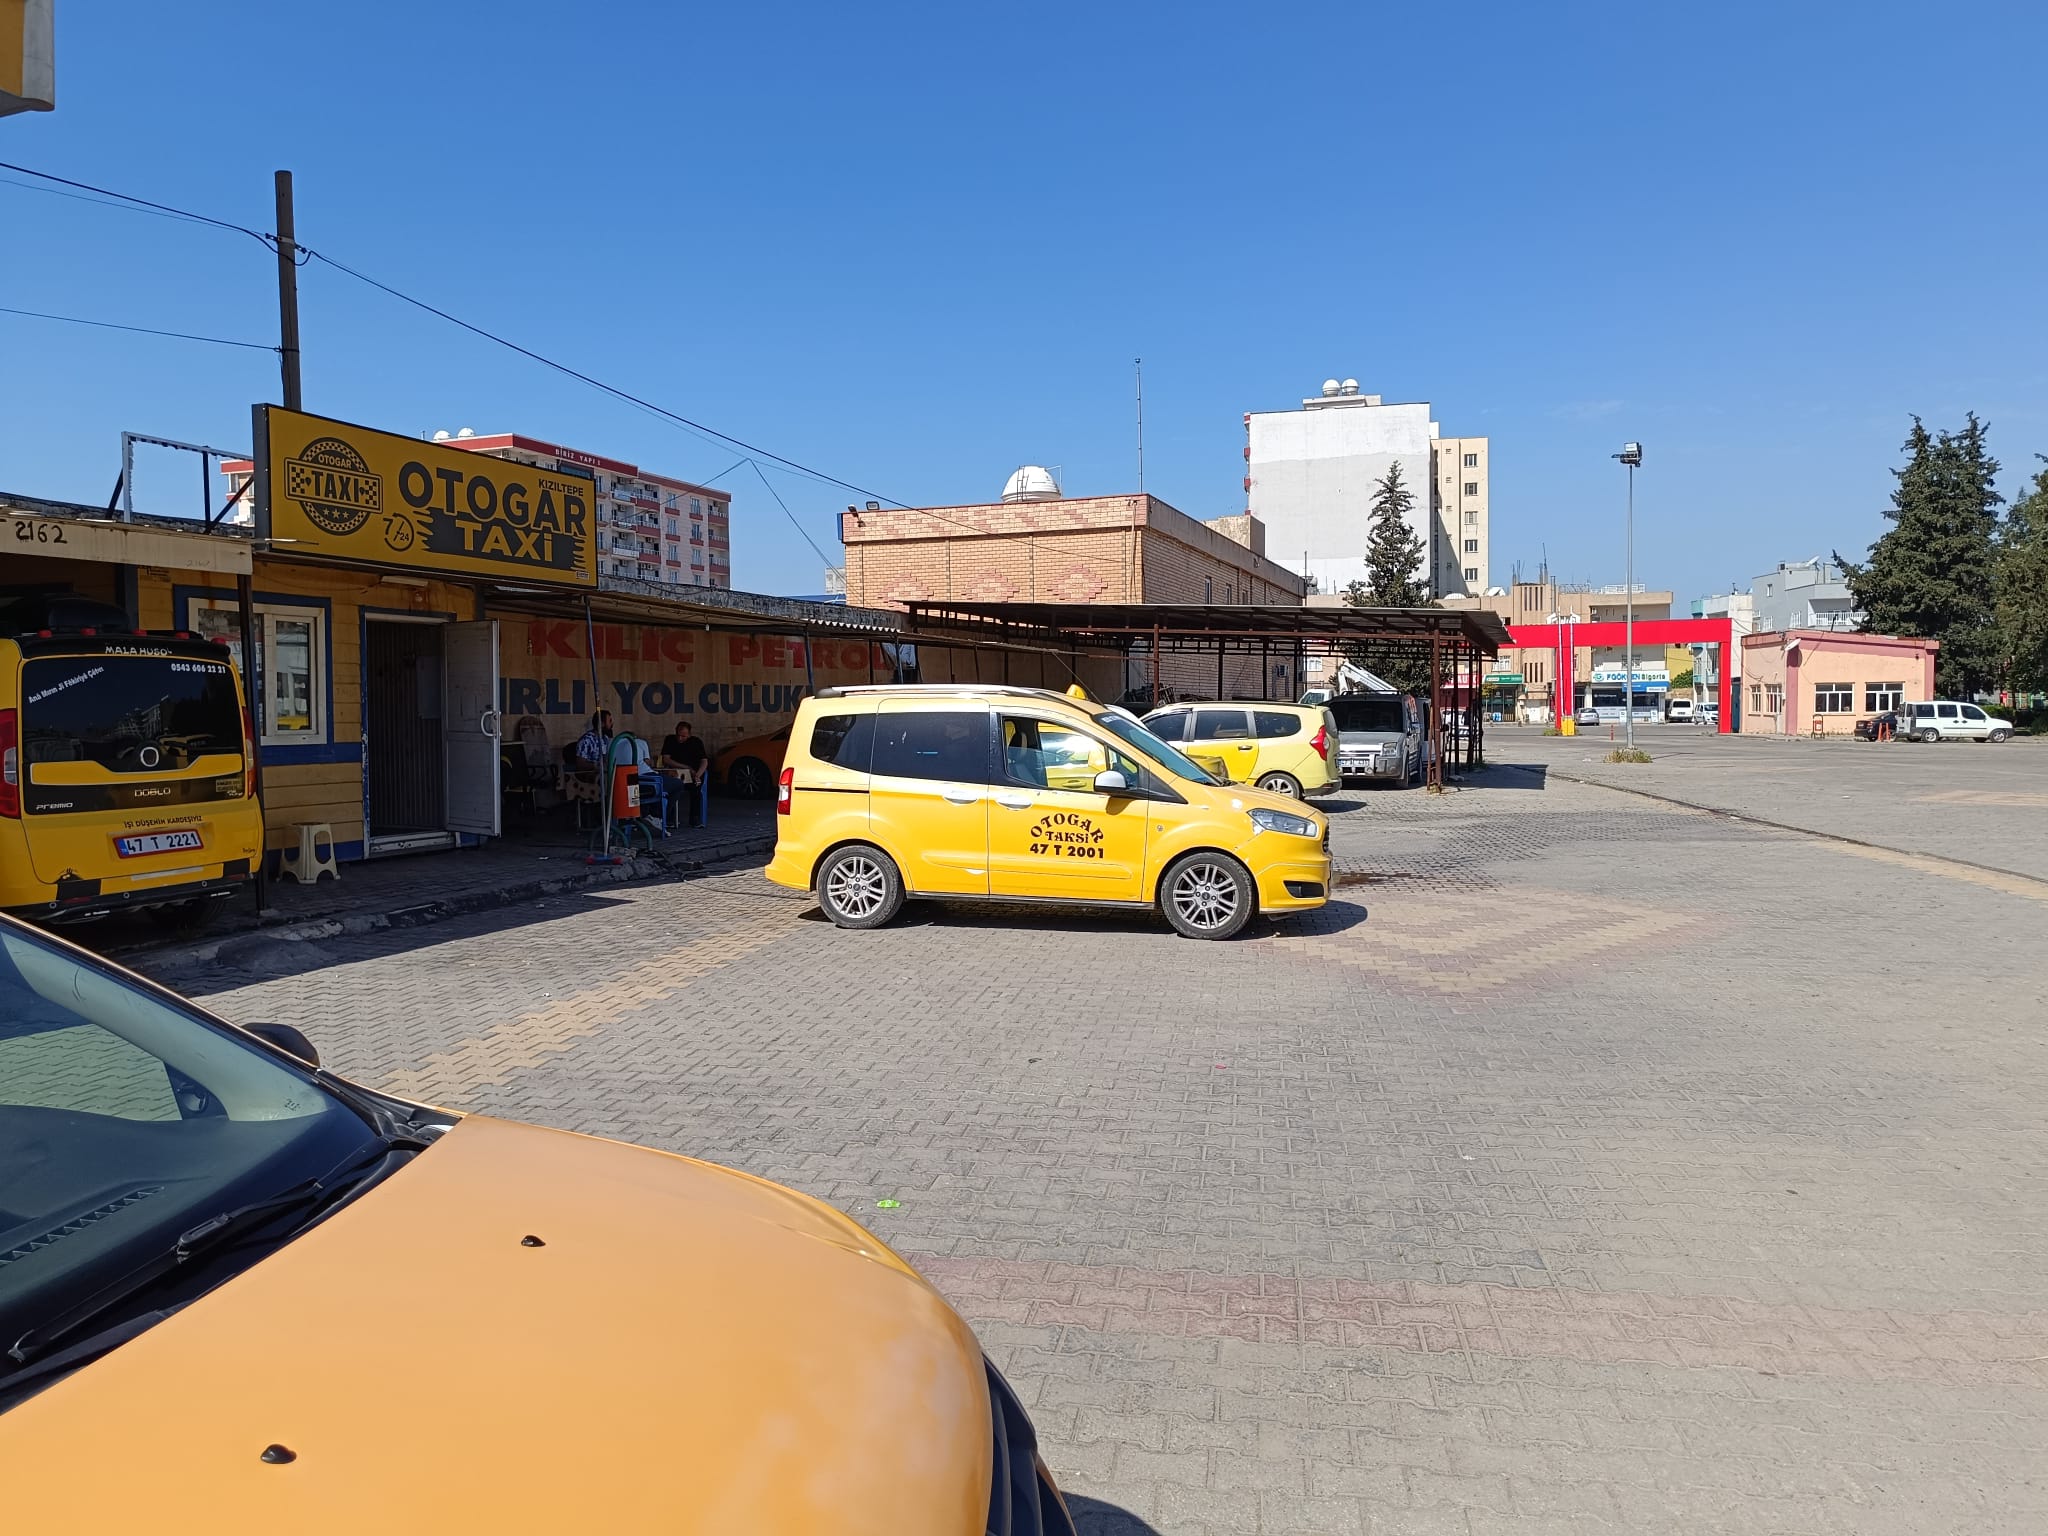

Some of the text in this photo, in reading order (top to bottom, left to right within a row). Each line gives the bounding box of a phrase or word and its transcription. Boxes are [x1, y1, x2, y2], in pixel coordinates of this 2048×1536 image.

[318, 453, 352, 469] OTOGAR
[311, 470, 360, 503] TAXI
[538, 478, 584, 496] KIZILTEPE
[399, 461, 586, 536] OTOGAR
[15, 520, 67, 544] 2162
[528, 621, 695, 673] KILIÇ
[731, 636, 892, 670] PETROL
[170, 663, 190, 672] 0543
[207, 665, 216, 673] 22
[217, 665, 226, 674] 21
[134, 787, 171, 797] DOBLO
[1030, 813, 1104, 844] OTOGAR
[126, 833, 198, 852] 47 T 2221
[1030, 843, 1104, 858] 47 T 2001
